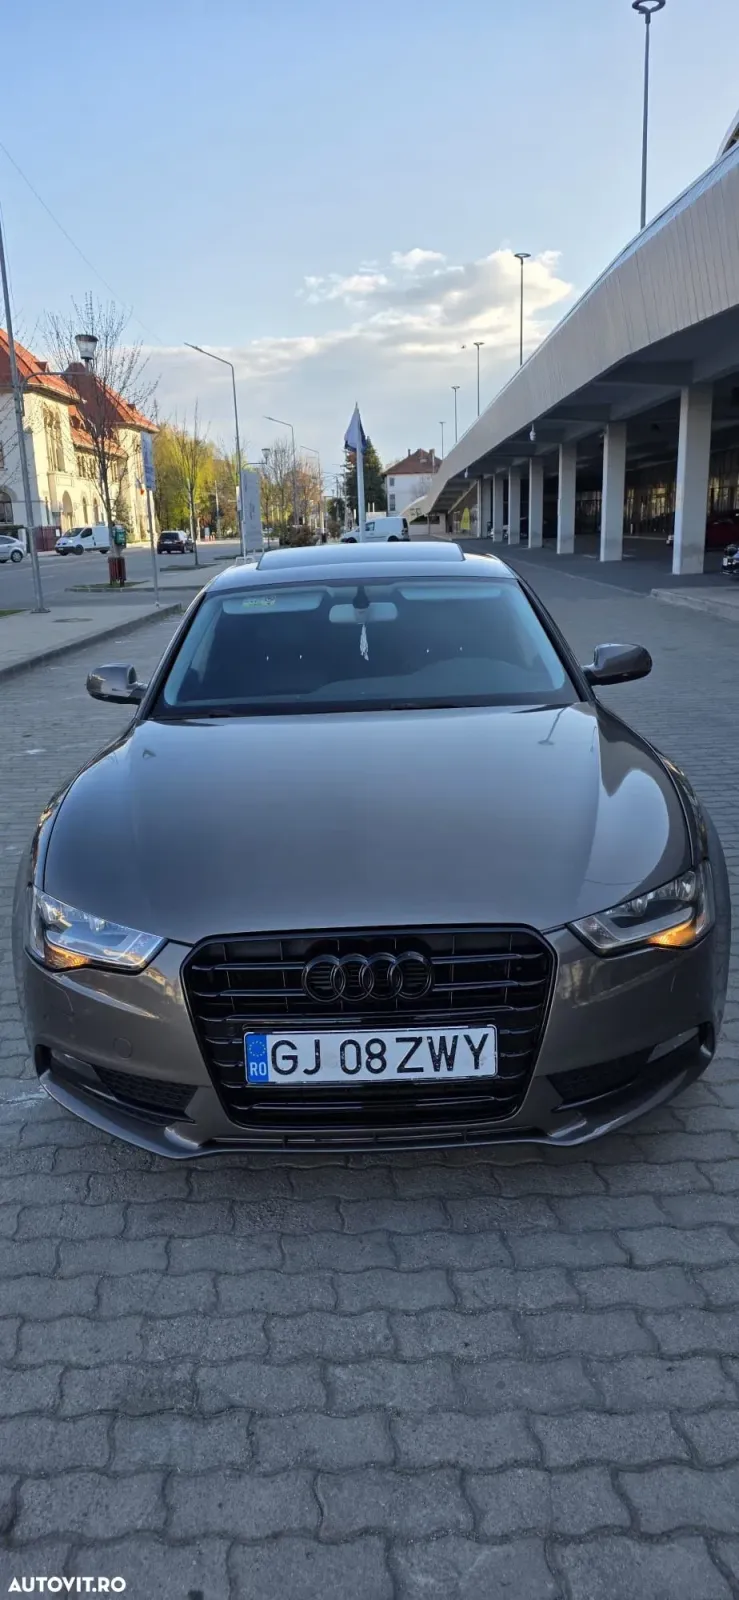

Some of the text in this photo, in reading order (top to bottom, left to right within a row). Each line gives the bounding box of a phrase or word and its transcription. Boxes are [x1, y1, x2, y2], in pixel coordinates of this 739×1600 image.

[250, 1061, 268, 1077] RO
[271, 1033, 489, 1076] GJ 08 ZWY
